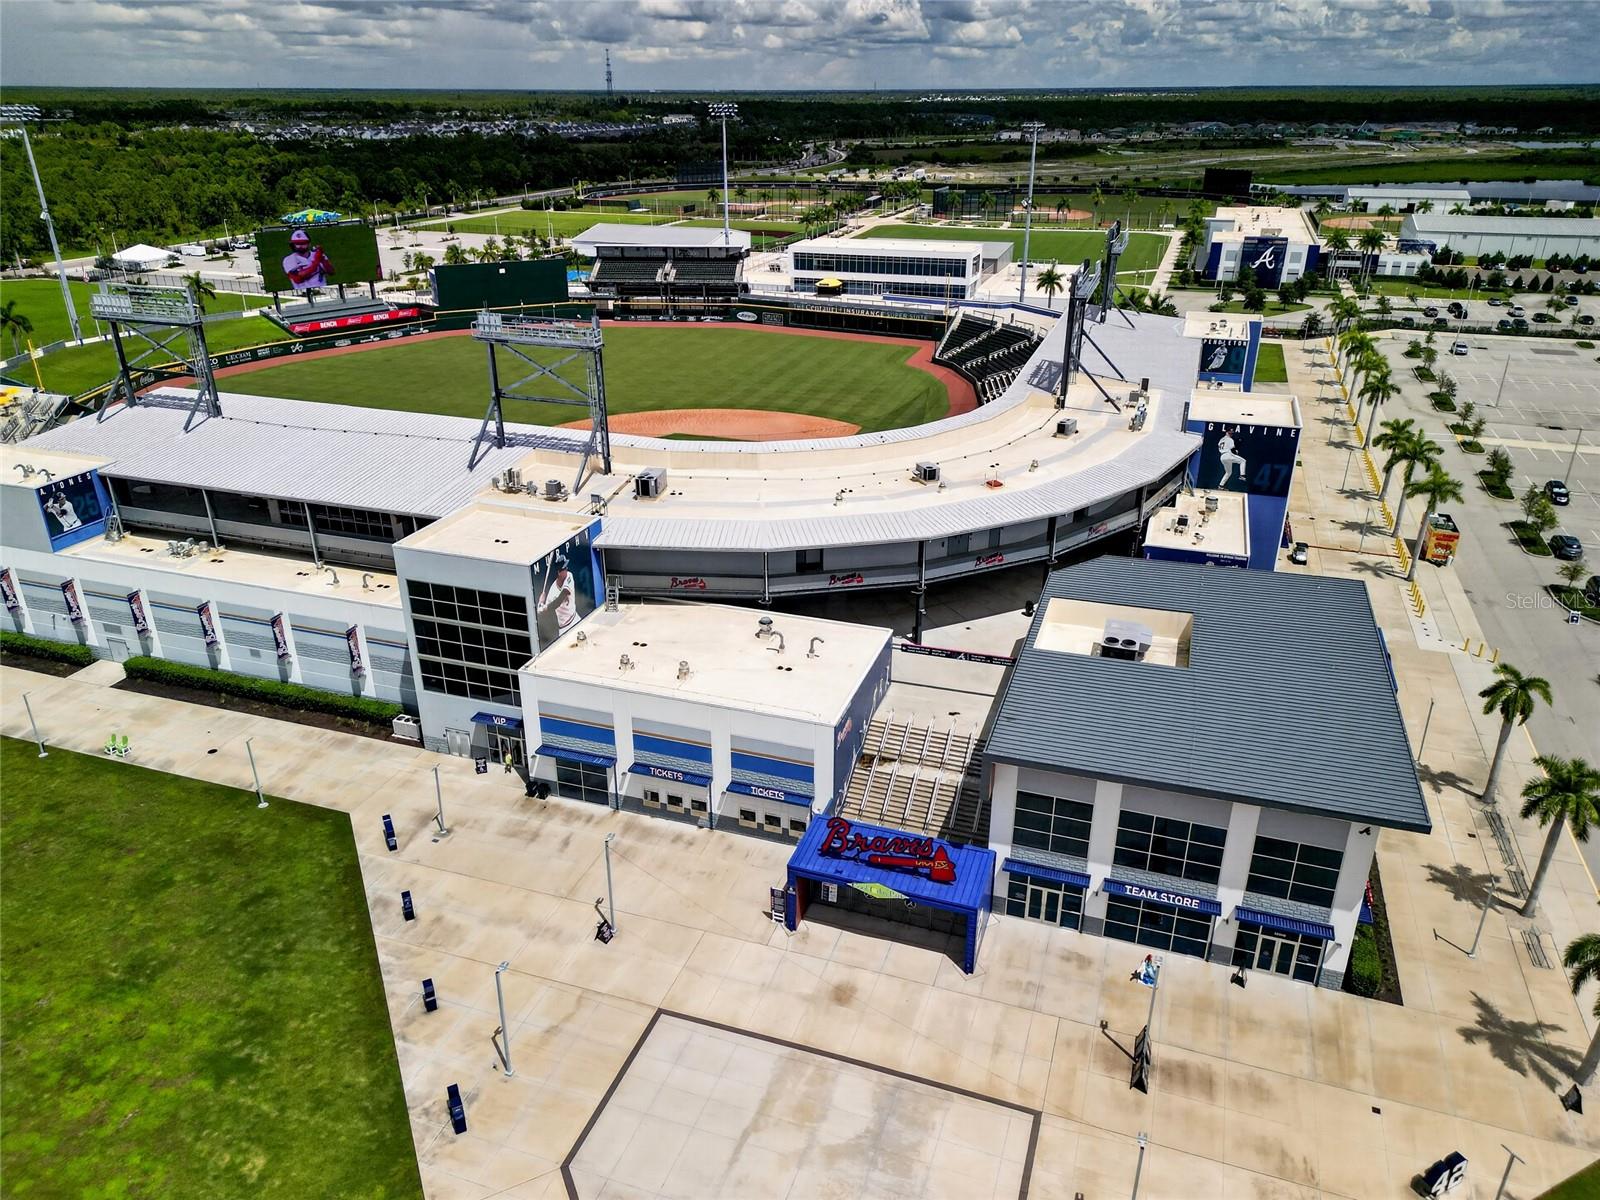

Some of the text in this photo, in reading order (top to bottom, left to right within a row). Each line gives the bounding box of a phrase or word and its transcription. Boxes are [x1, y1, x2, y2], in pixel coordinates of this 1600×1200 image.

[843, 308, 884, 318] INSURANCE
[320, 320, 338, 329] BENCH
[1208, 422, 1297, 438] GLAVINE
[51, 472, 92, 492] JONES
[1253, 463, 1289, 493] 47
[533, 528, 589, 575] MURPHY
[492, 716, 507, 726] VIP
[649, 766, 684, 781] TICKETS
[750, 786, 785, 800] TICKETS
[820, 816, 934, 857] Braves
[1124, 885, 1200, 909] TEAM STORE
[1431, 1160, 1468, 1196] 42
